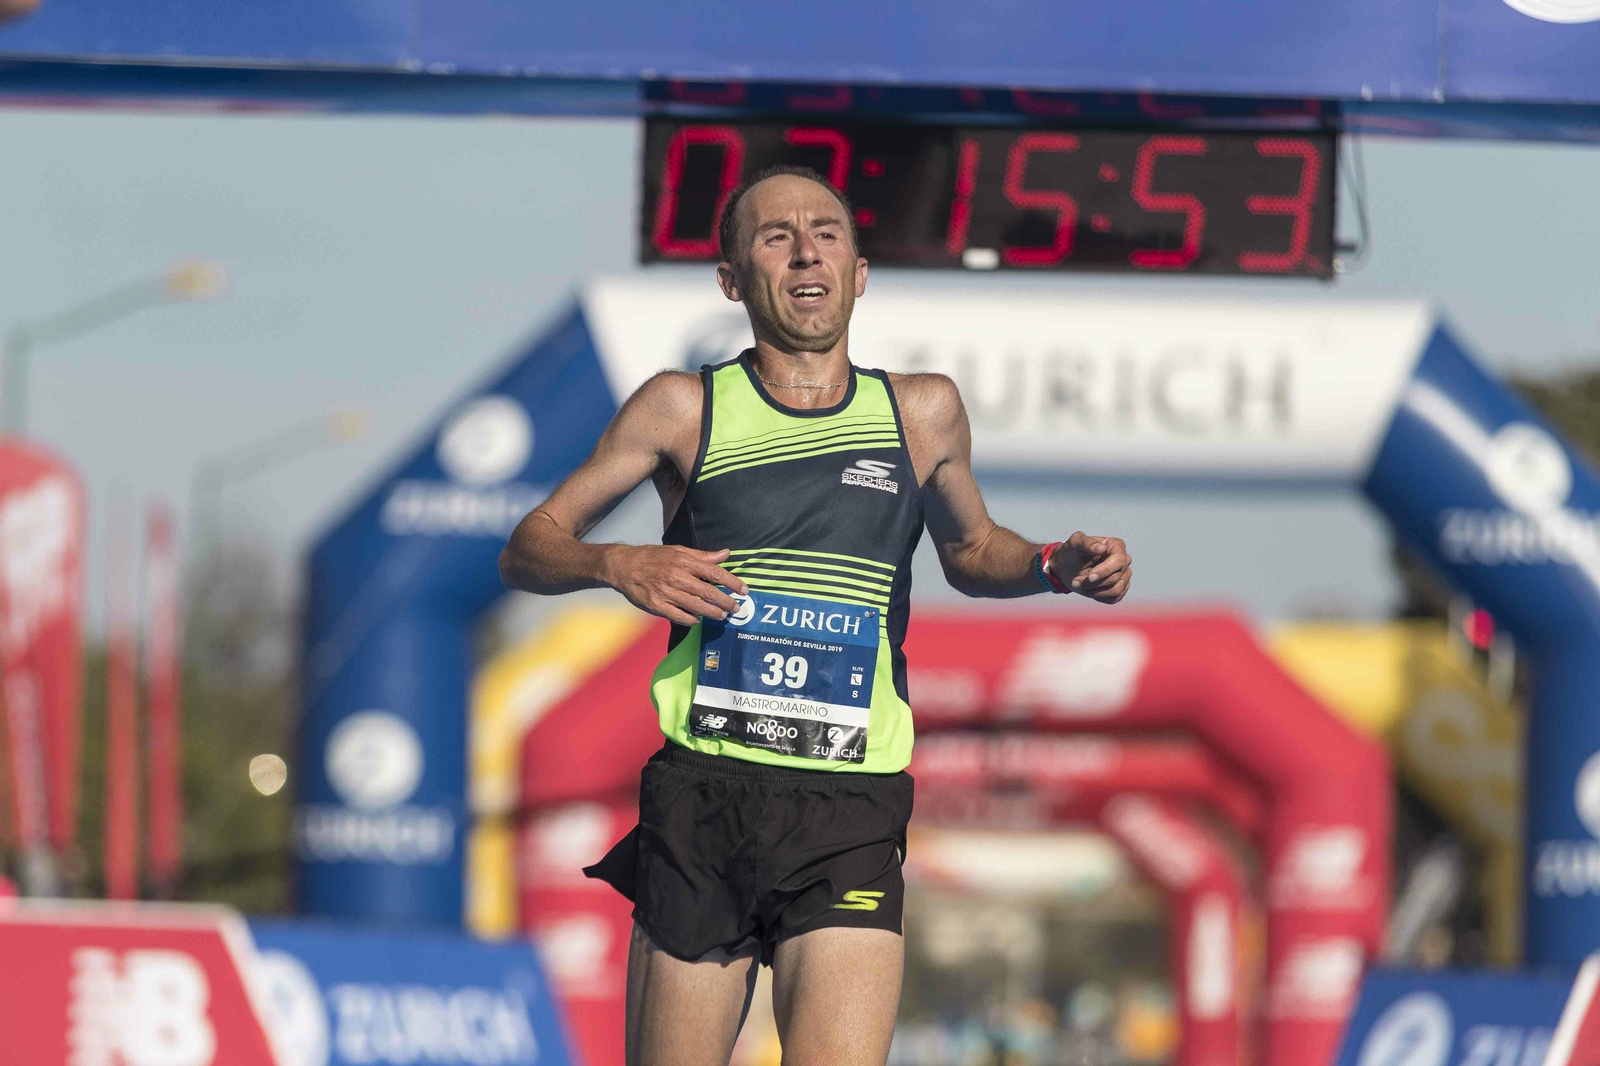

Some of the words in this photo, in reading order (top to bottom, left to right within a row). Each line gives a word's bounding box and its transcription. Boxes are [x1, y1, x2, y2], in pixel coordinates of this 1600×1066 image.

[842, 473, 898, 489] SKECHERS
[842, 480, 898, 494] PERFORMANCE
[760, 604, 861, 635] ZURICH
[737, 632, 760, 641] ZURICH
[760, 636, 793, 646] MARATÓN
[803, 642, 827, 651] SEVILLA
[828, 645, 843, 653] 2019
[760, 652, 808, 689] 39
[852, 690, 858, 698] S
[732, 695, 829, 717] MASTROMARINO
[812, 745, 858, 759] ZURICH
